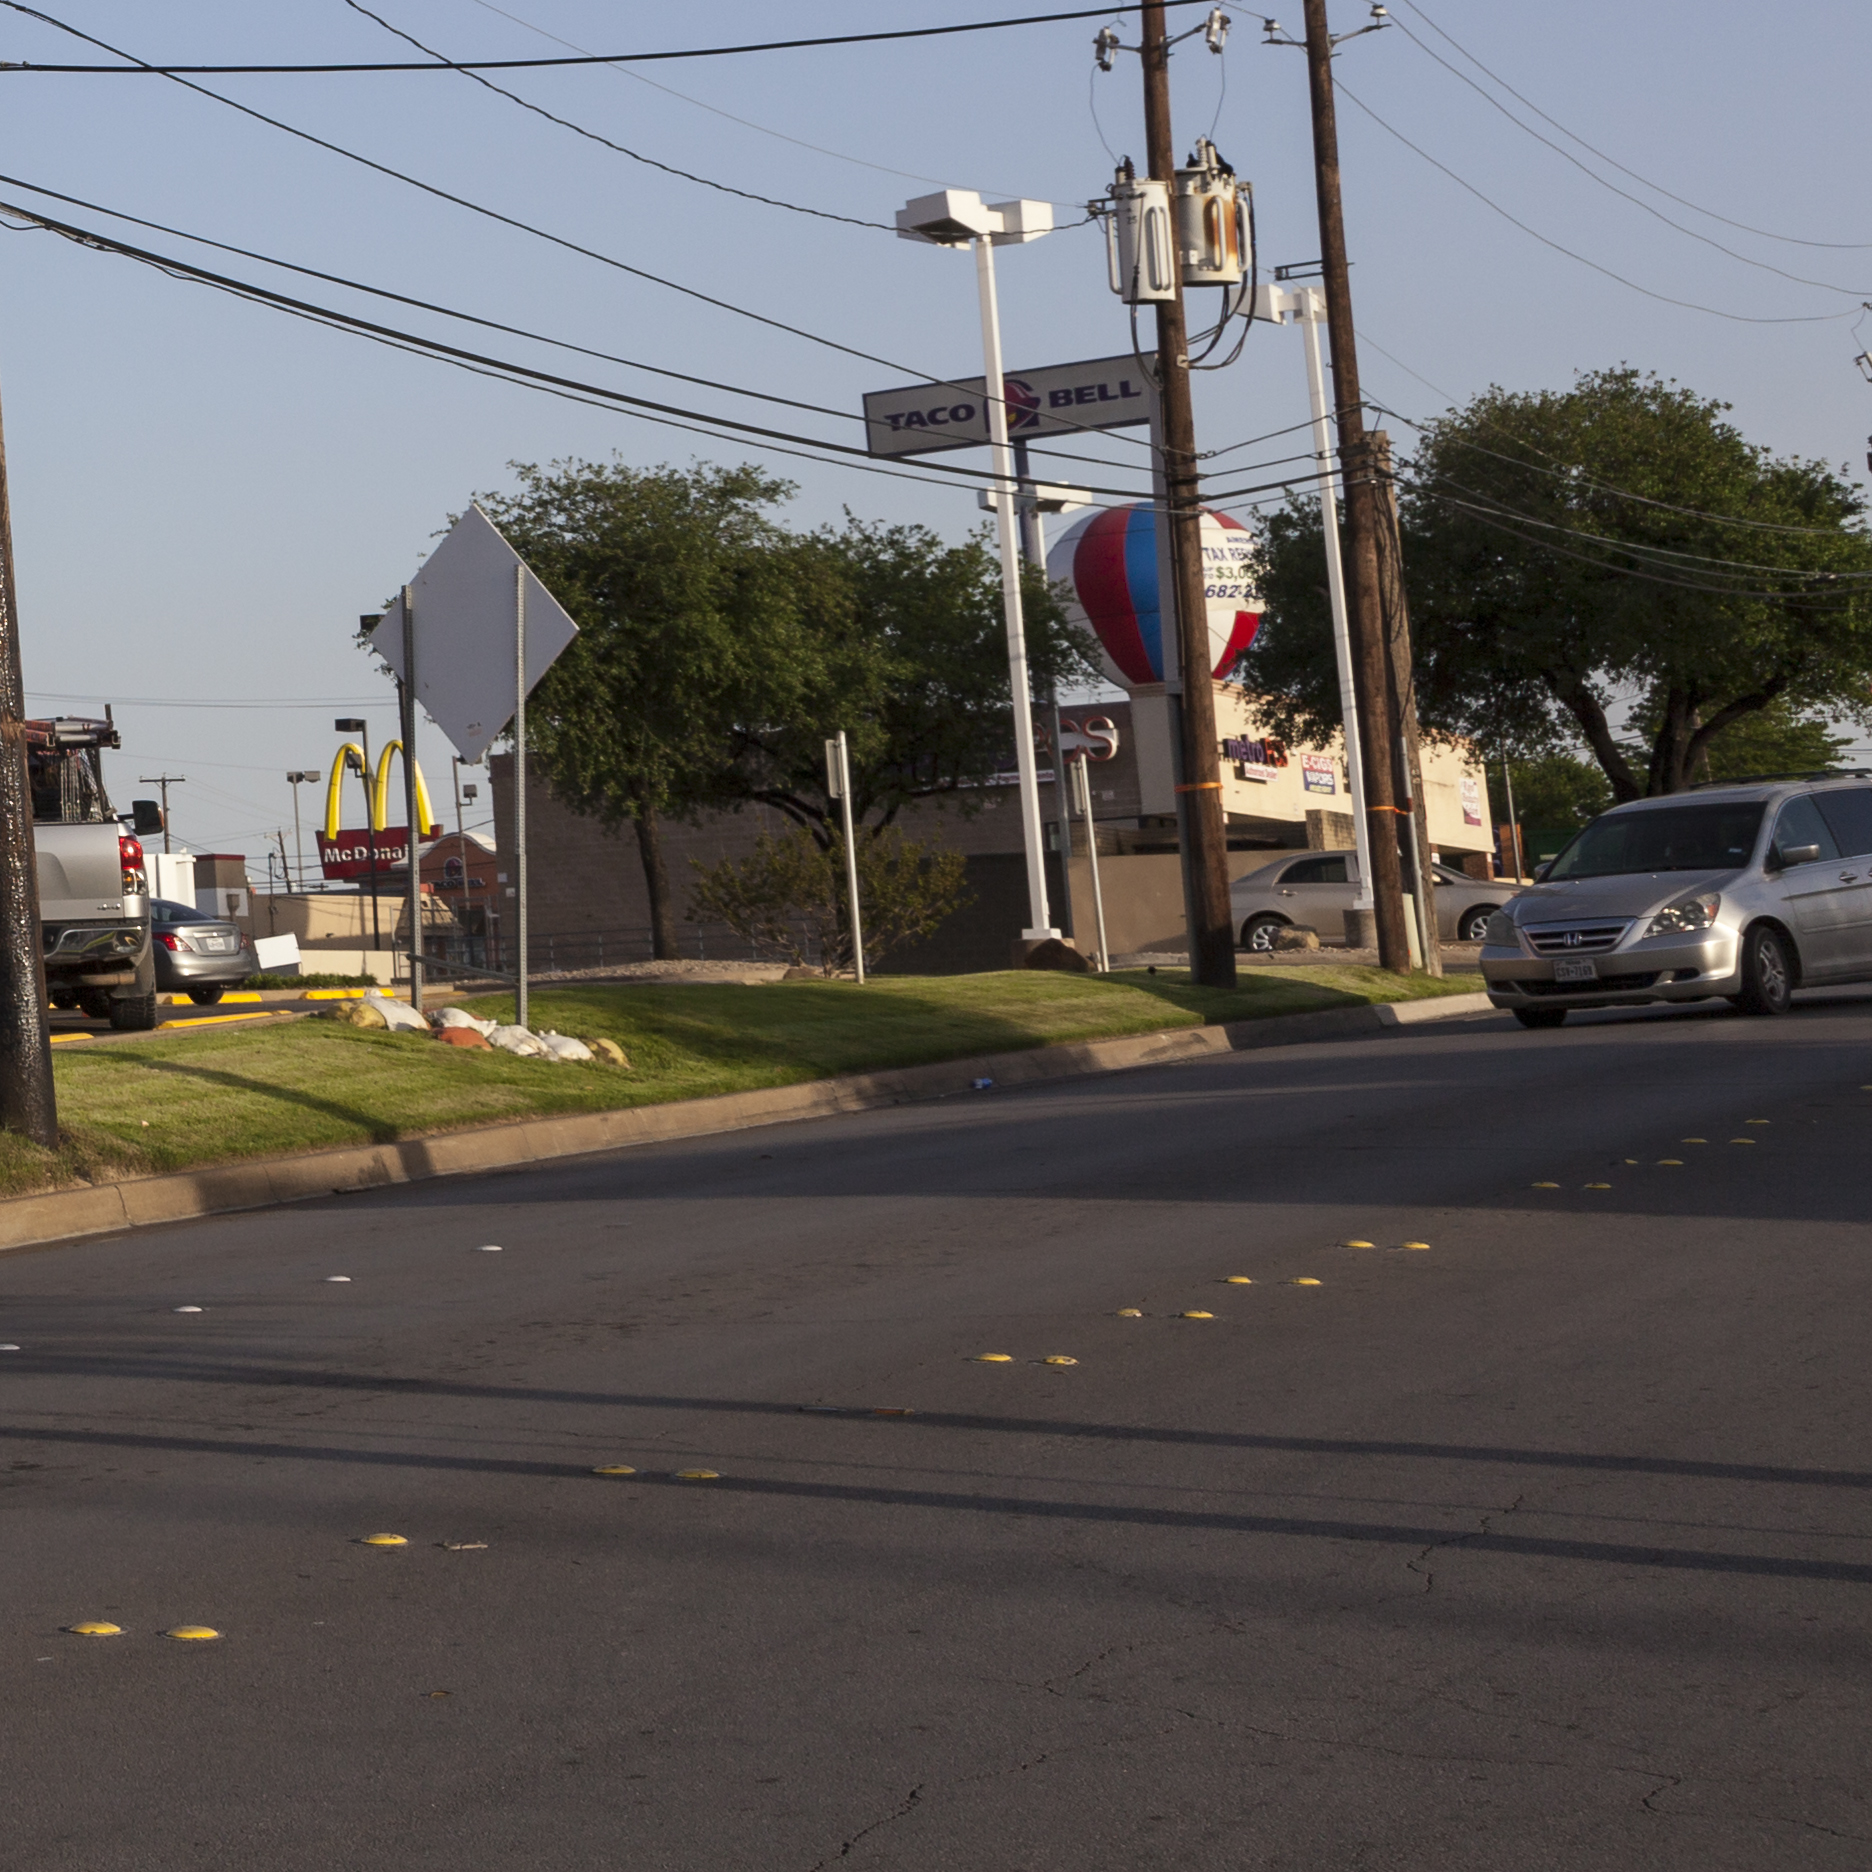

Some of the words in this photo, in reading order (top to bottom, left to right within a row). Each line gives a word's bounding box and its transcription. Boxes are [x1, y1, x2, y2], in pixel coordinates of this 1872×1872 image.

[884, 403, 976, 432] TACO
[1048, 380, 1143, 409] BELL
[1201, 547, 1228, 562] TAX
